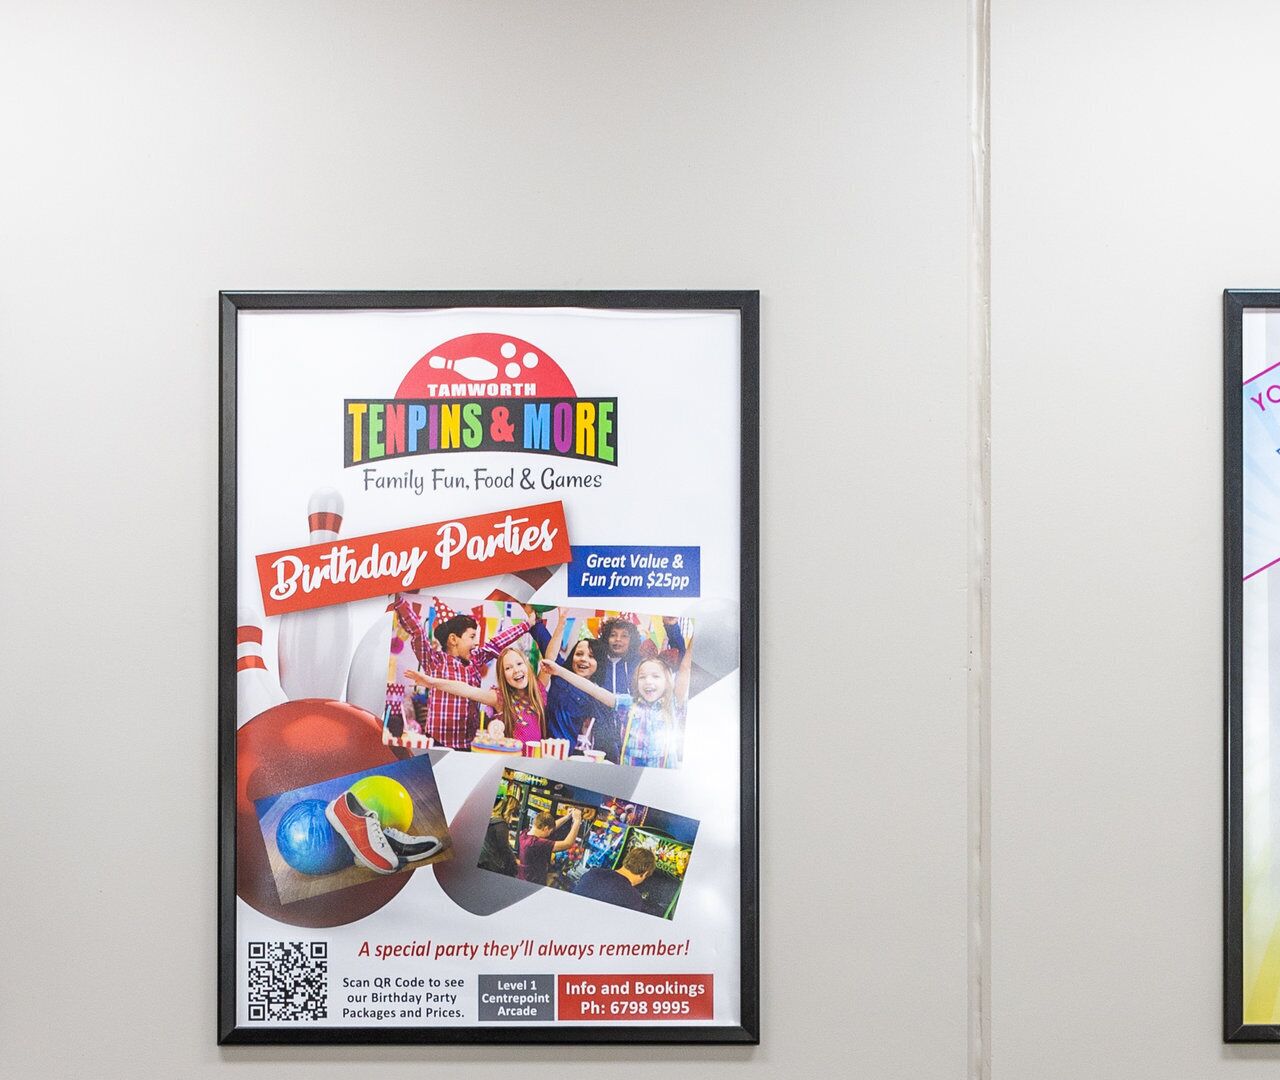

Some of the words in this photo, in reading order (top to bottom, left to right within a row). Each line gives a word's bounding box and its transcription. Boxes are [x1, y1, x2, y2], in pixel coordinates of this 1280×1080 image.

[426, 383, 536, 397] TAMWORTH
[348, 402, 483, 462] TENPINS
[490, 406, 515, 442] &
[523, 402, 614, 462] MORE
[269, 543, 428, 601] Birthday
[434, 515, 558, 570] Parties
[357, 941, 370, 957] A
[374, 940, 431, 961] special
[434, 942, 479, 960] party
[483, 939, 534, 960] they’ll
[537, 939, 594, 960] always
[598, 939, 690, 956] remember!
[566, 980, 596, 995] Info
[600, 980, 629, 995] and
[634, 980, 705, 997] Bookings
[580, 1000, 605, 1014] Ph:
[610, 1000, 648, 1014] 6798
[652, 1000, 689, 1014] 9995
